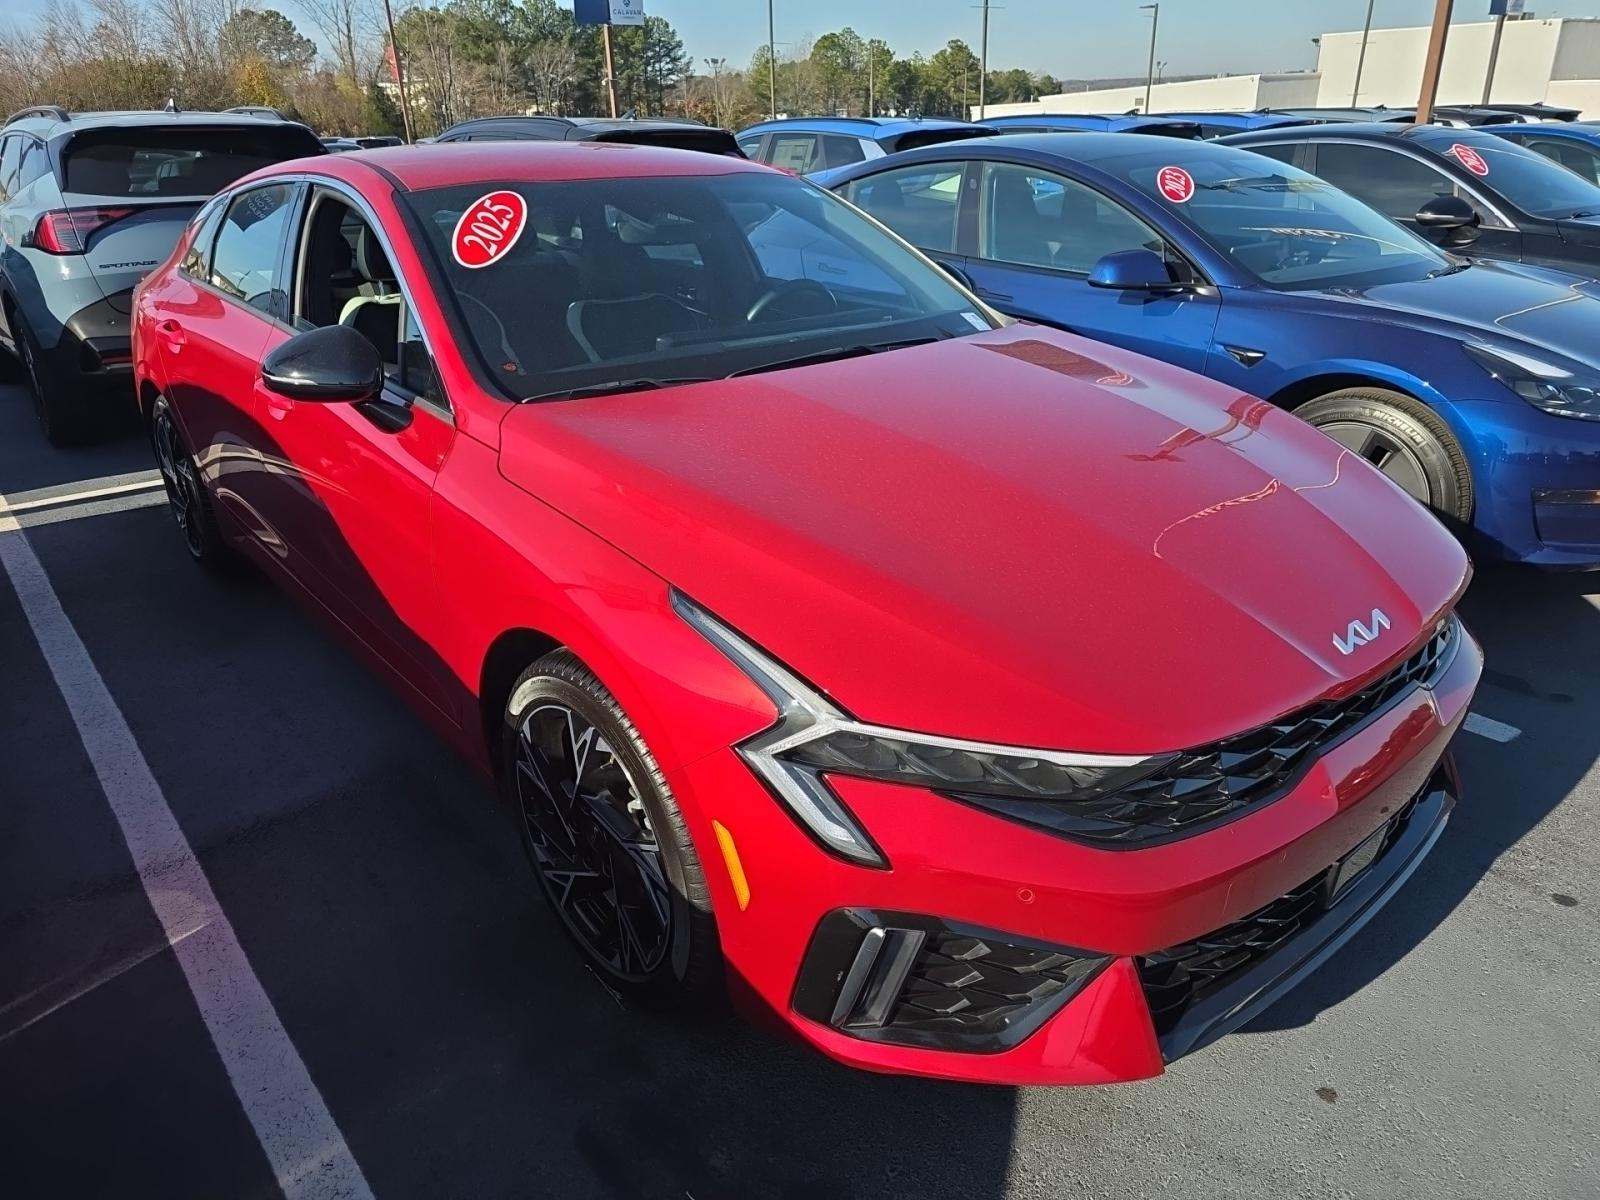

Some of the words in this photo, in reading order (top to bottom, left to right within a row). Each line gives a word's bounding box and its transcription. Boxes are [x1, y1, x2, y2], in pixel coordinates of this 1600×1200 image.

[463, 198, 515, 257] 2025
[99, 260, 159, 269] SPORTAGE
[1373, 410, 1424, 445] MICHELIN
[1332, 608, 1391, 655] KIA
